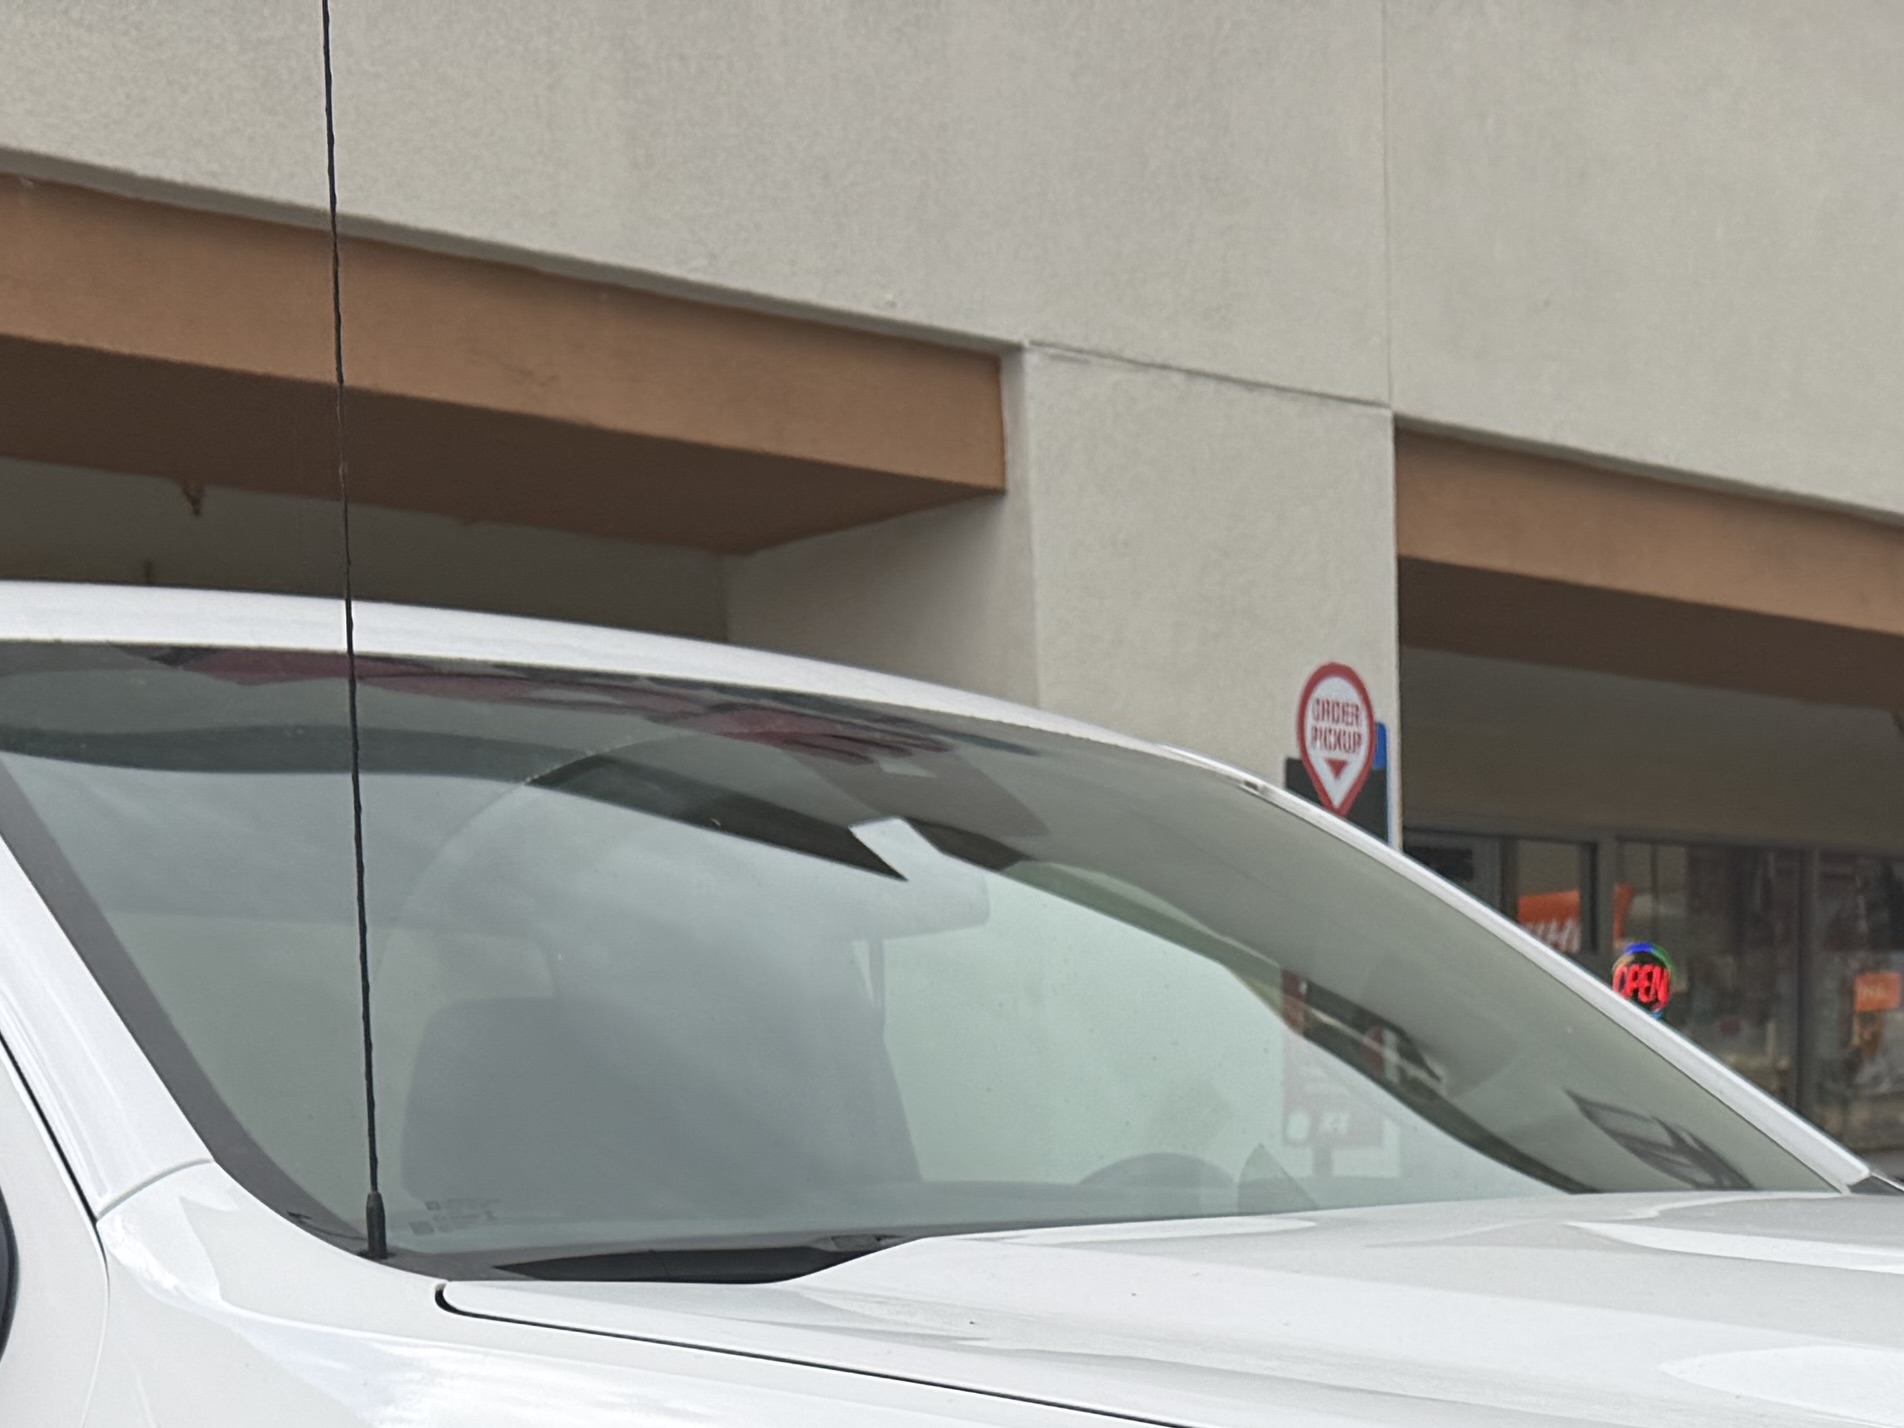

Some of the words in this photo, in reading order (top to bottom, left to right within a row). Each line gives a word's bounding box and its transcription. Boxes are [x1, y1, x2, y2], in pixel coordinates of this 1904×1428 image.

[1313, 697, 1361, 726] ORDER
[1310, 726, 1362, 754] PICKUP
[1612, 963, 1672, 1012] OPEN
